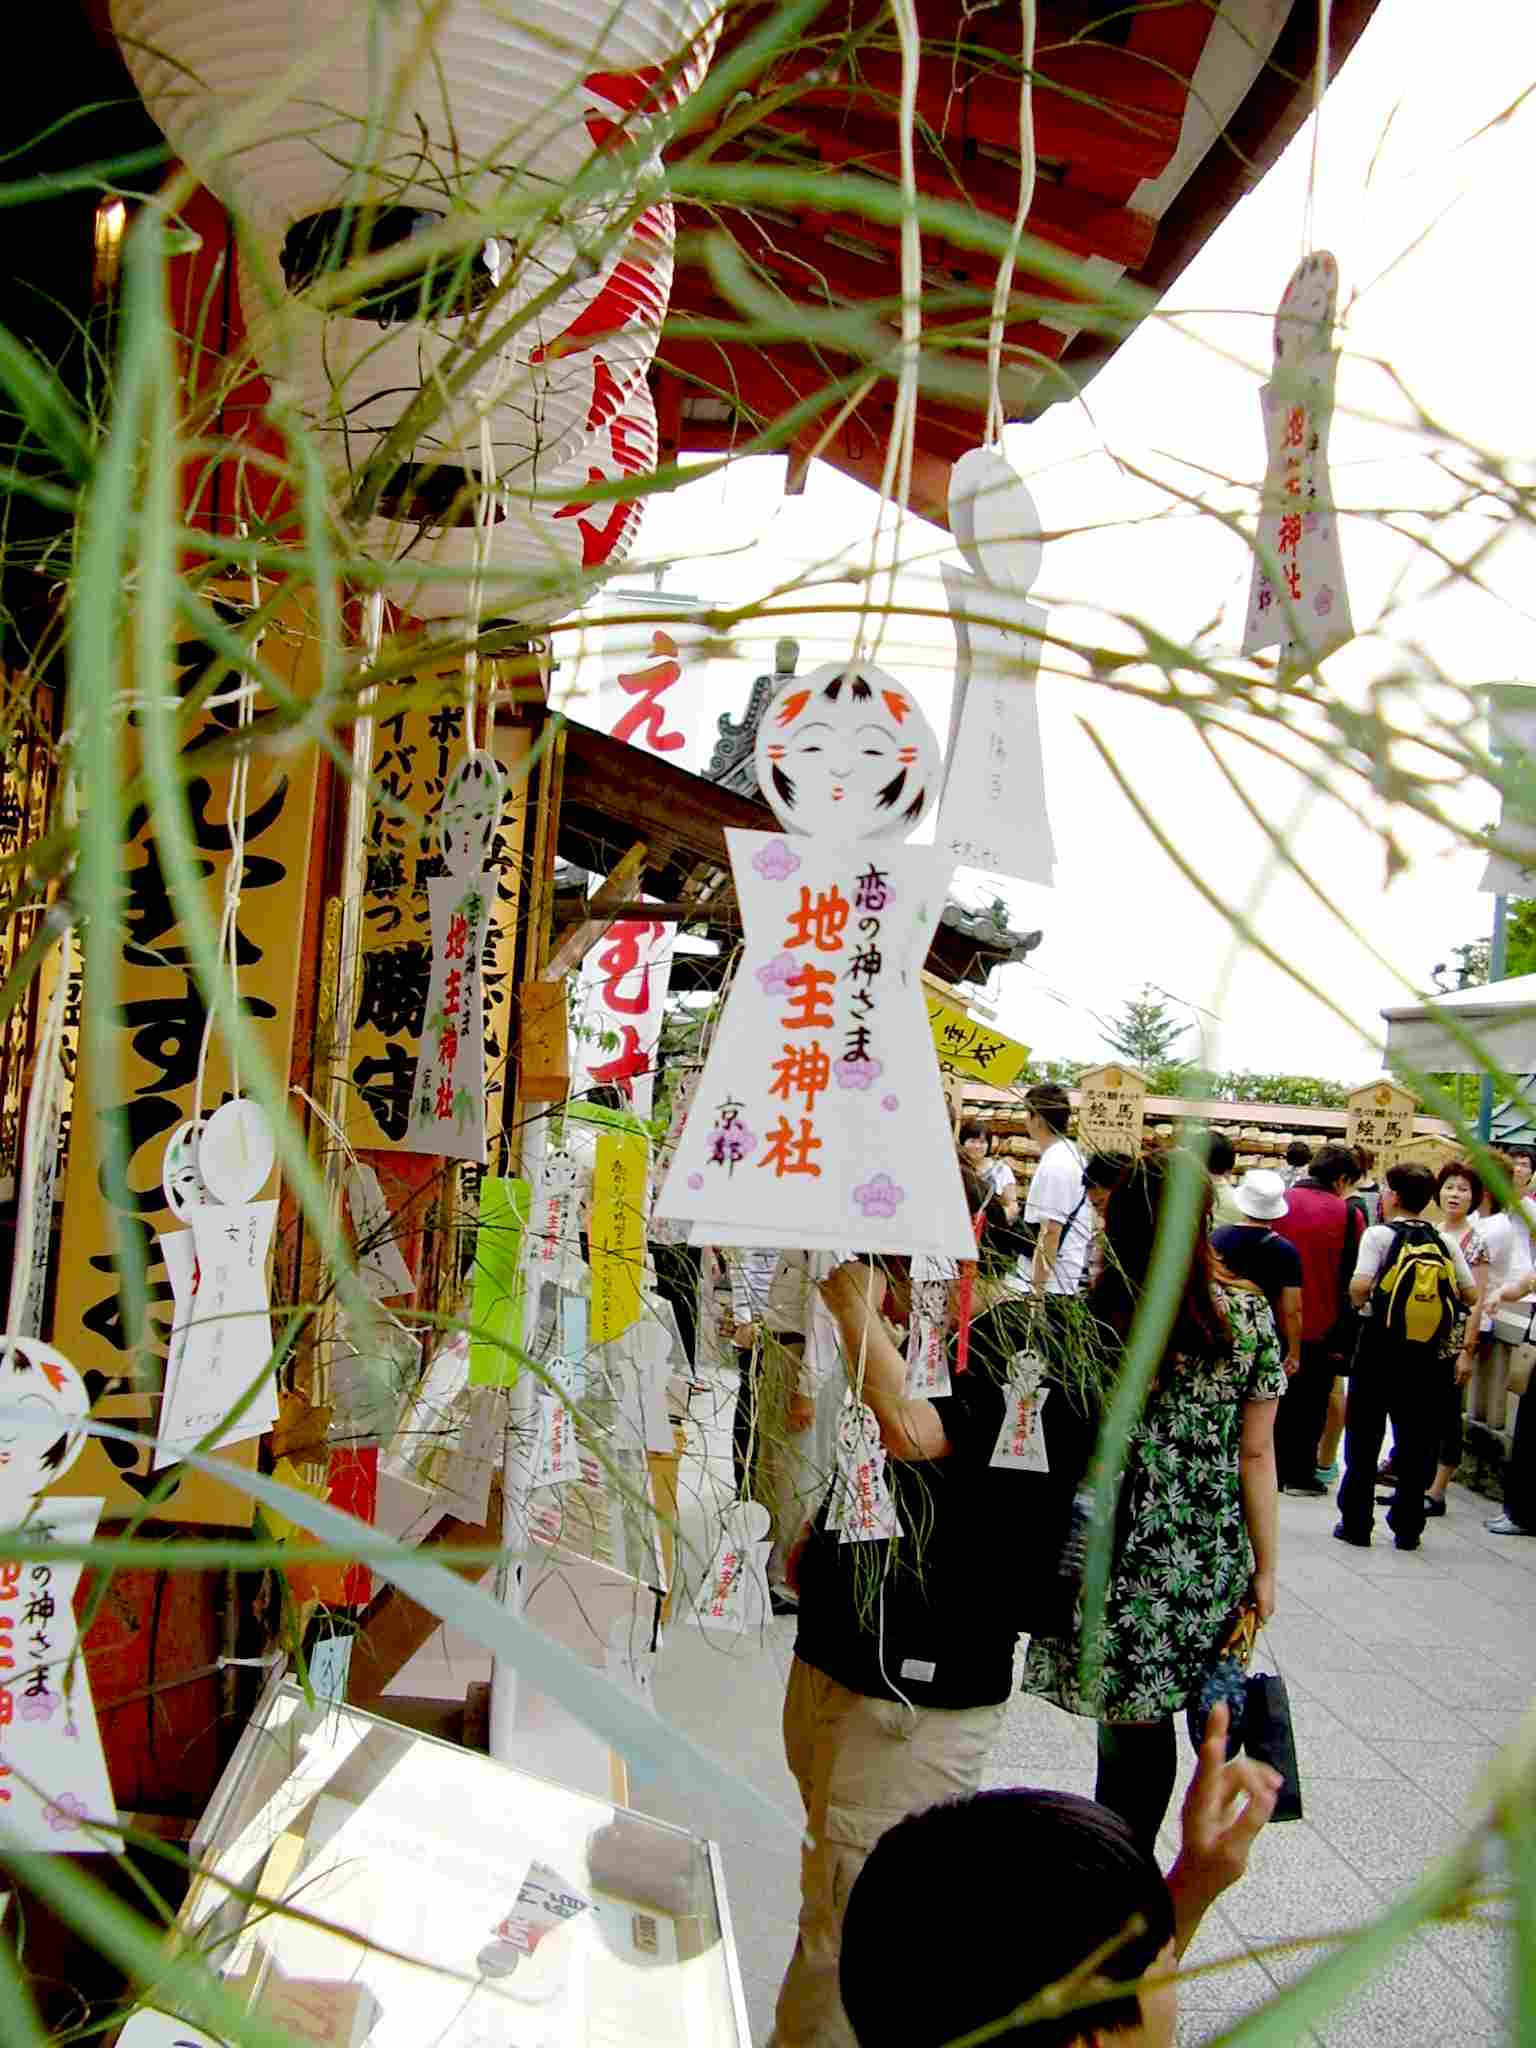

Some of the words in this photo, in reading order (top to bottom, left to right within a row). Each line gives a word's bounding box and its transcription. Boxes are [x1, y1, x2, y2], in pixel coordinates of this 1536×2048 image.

[758, 883, 850, 1178] 地主神社
[844, 863, 889, 1062] 恋の神さま
[707, 1094, 745, 1179] 京都
